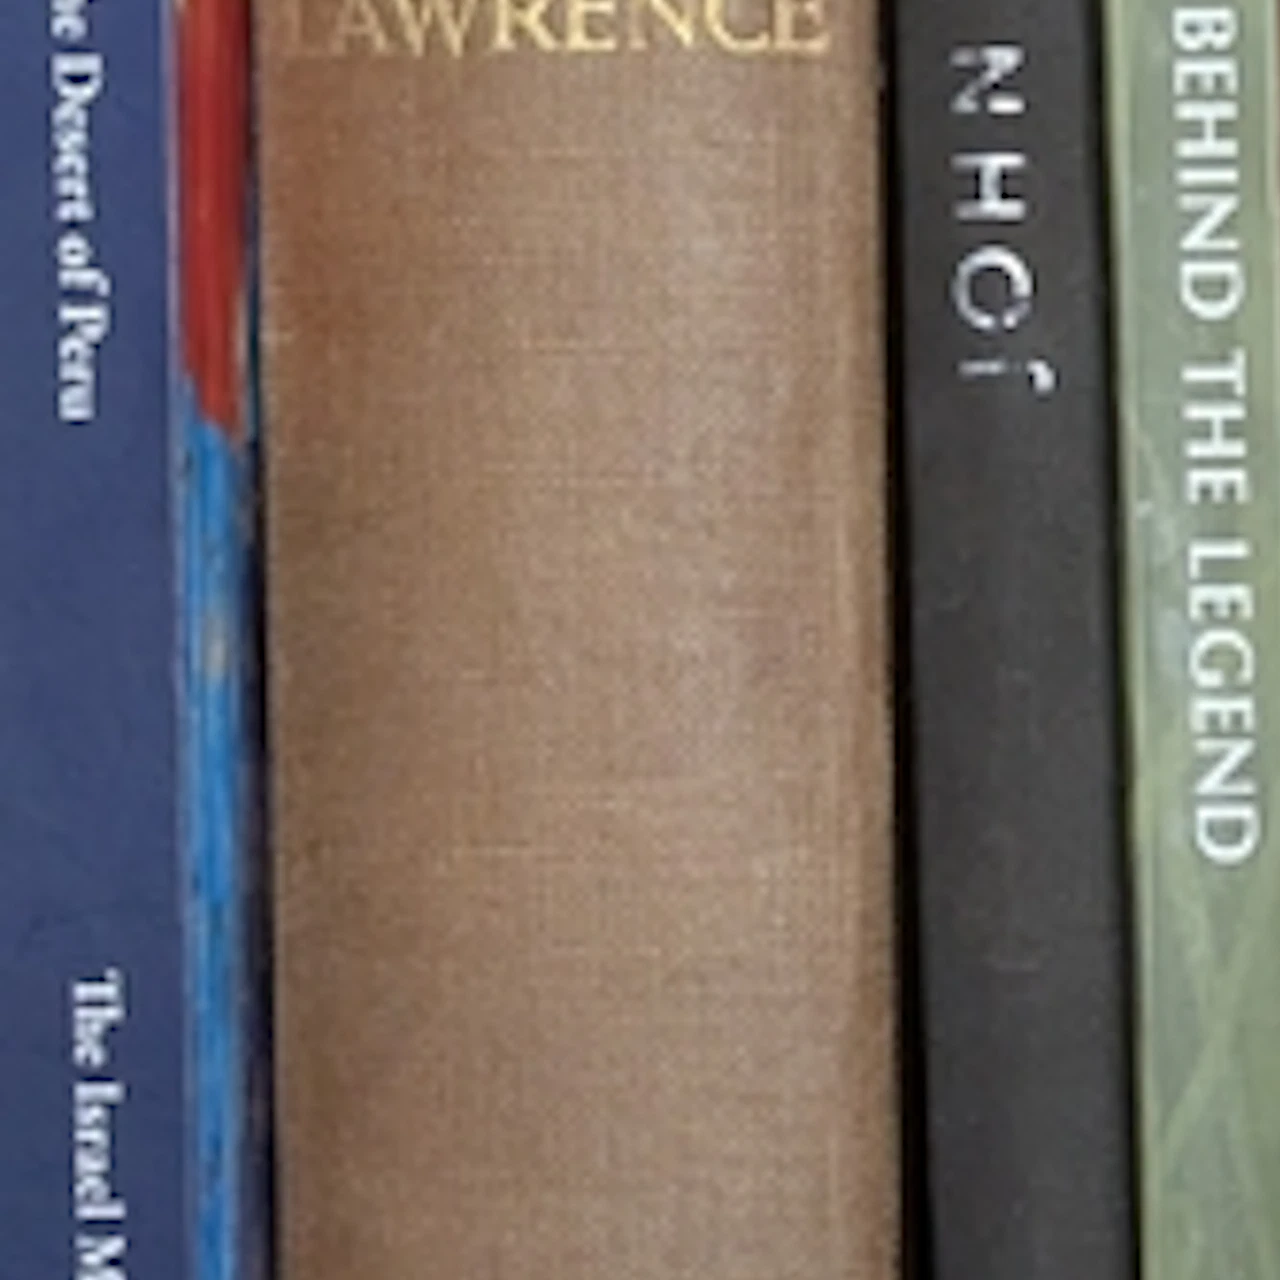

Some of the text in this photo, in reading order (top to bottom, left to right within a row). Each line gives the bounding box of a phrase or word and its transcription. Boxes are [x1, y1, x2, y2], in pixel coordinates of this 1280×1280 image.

[52, 50, 104, 223] Desert
[1172, 7, 1247, 320] BEHIND
[58, 233, 111, 290] of
[57, 303, 110, 422] Peru
[1179, 350, 1250, 504] THE
[1184, 540, 1263, 865] LEGEND
[72, 967, 126, 1067] The
[73, 1083, 128, 1220] Israel
